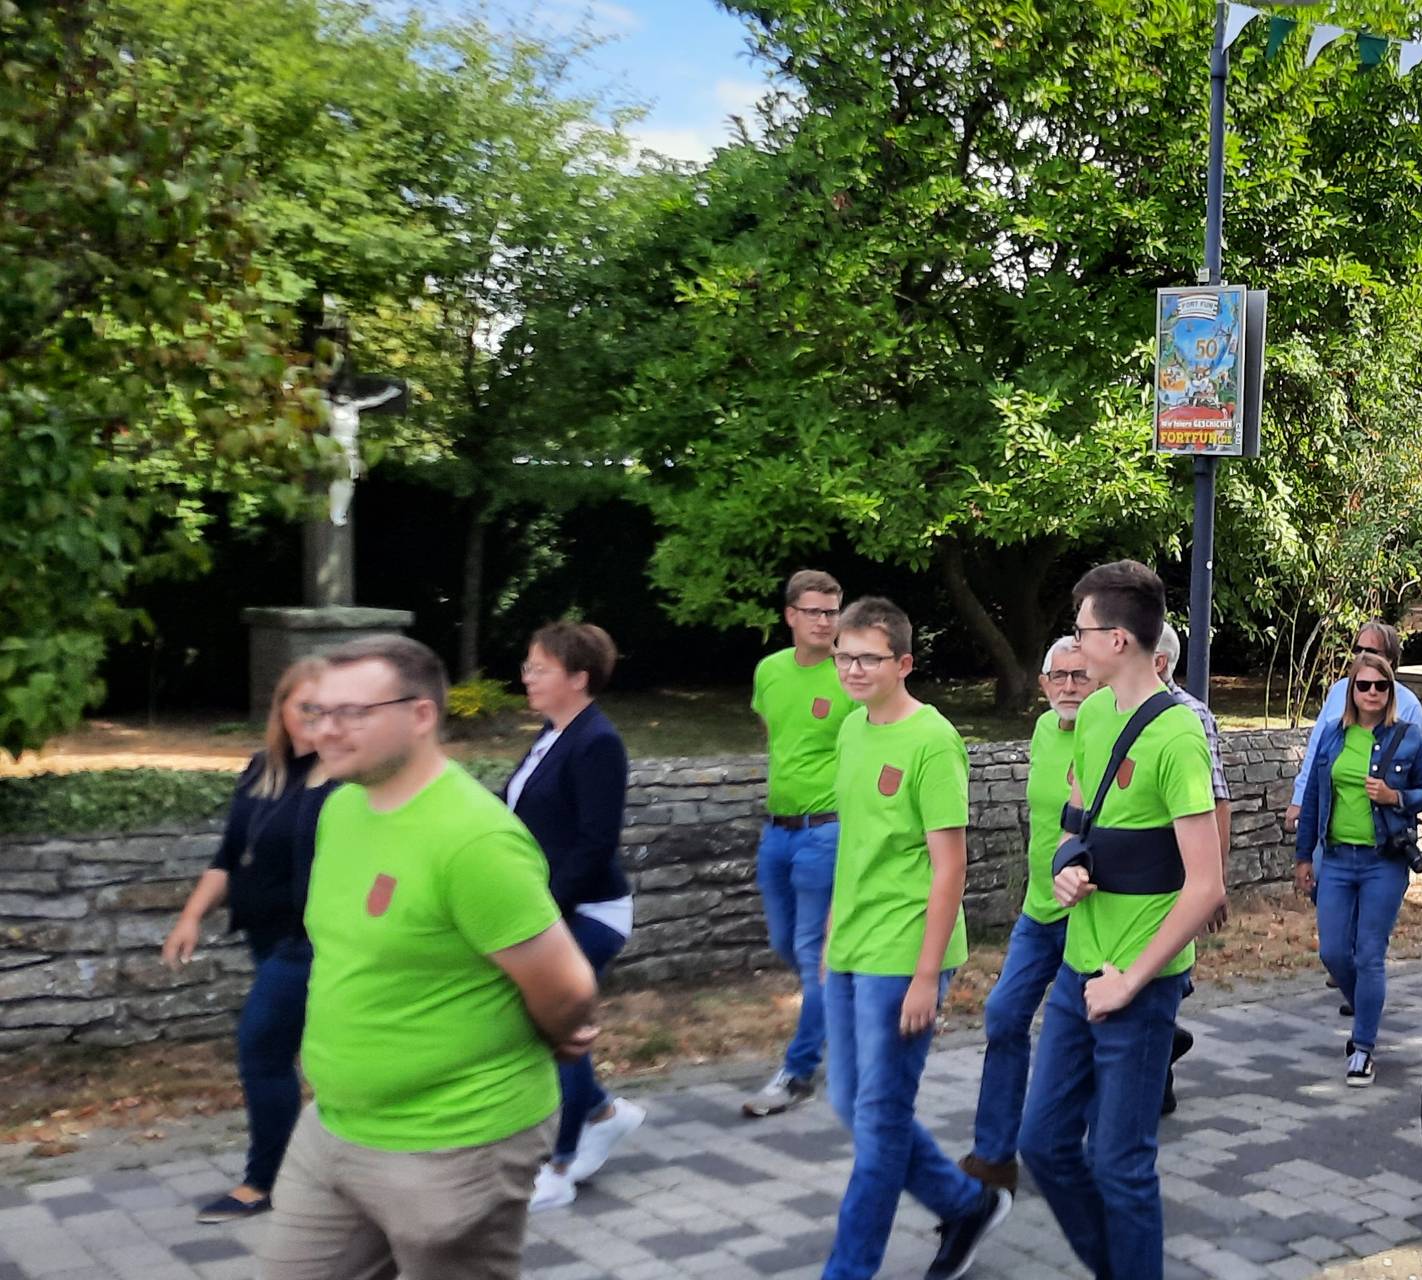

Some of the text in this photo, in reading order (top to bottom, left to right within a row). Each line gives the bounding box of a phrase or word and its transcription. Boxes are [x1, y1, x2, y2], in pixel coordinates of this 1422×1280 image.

[1181, 300, 1214, 309] FORT FUN
[1195, 338, 1218, 359] 50
[1193, 419, 1232, 428] GESCHICHTE
